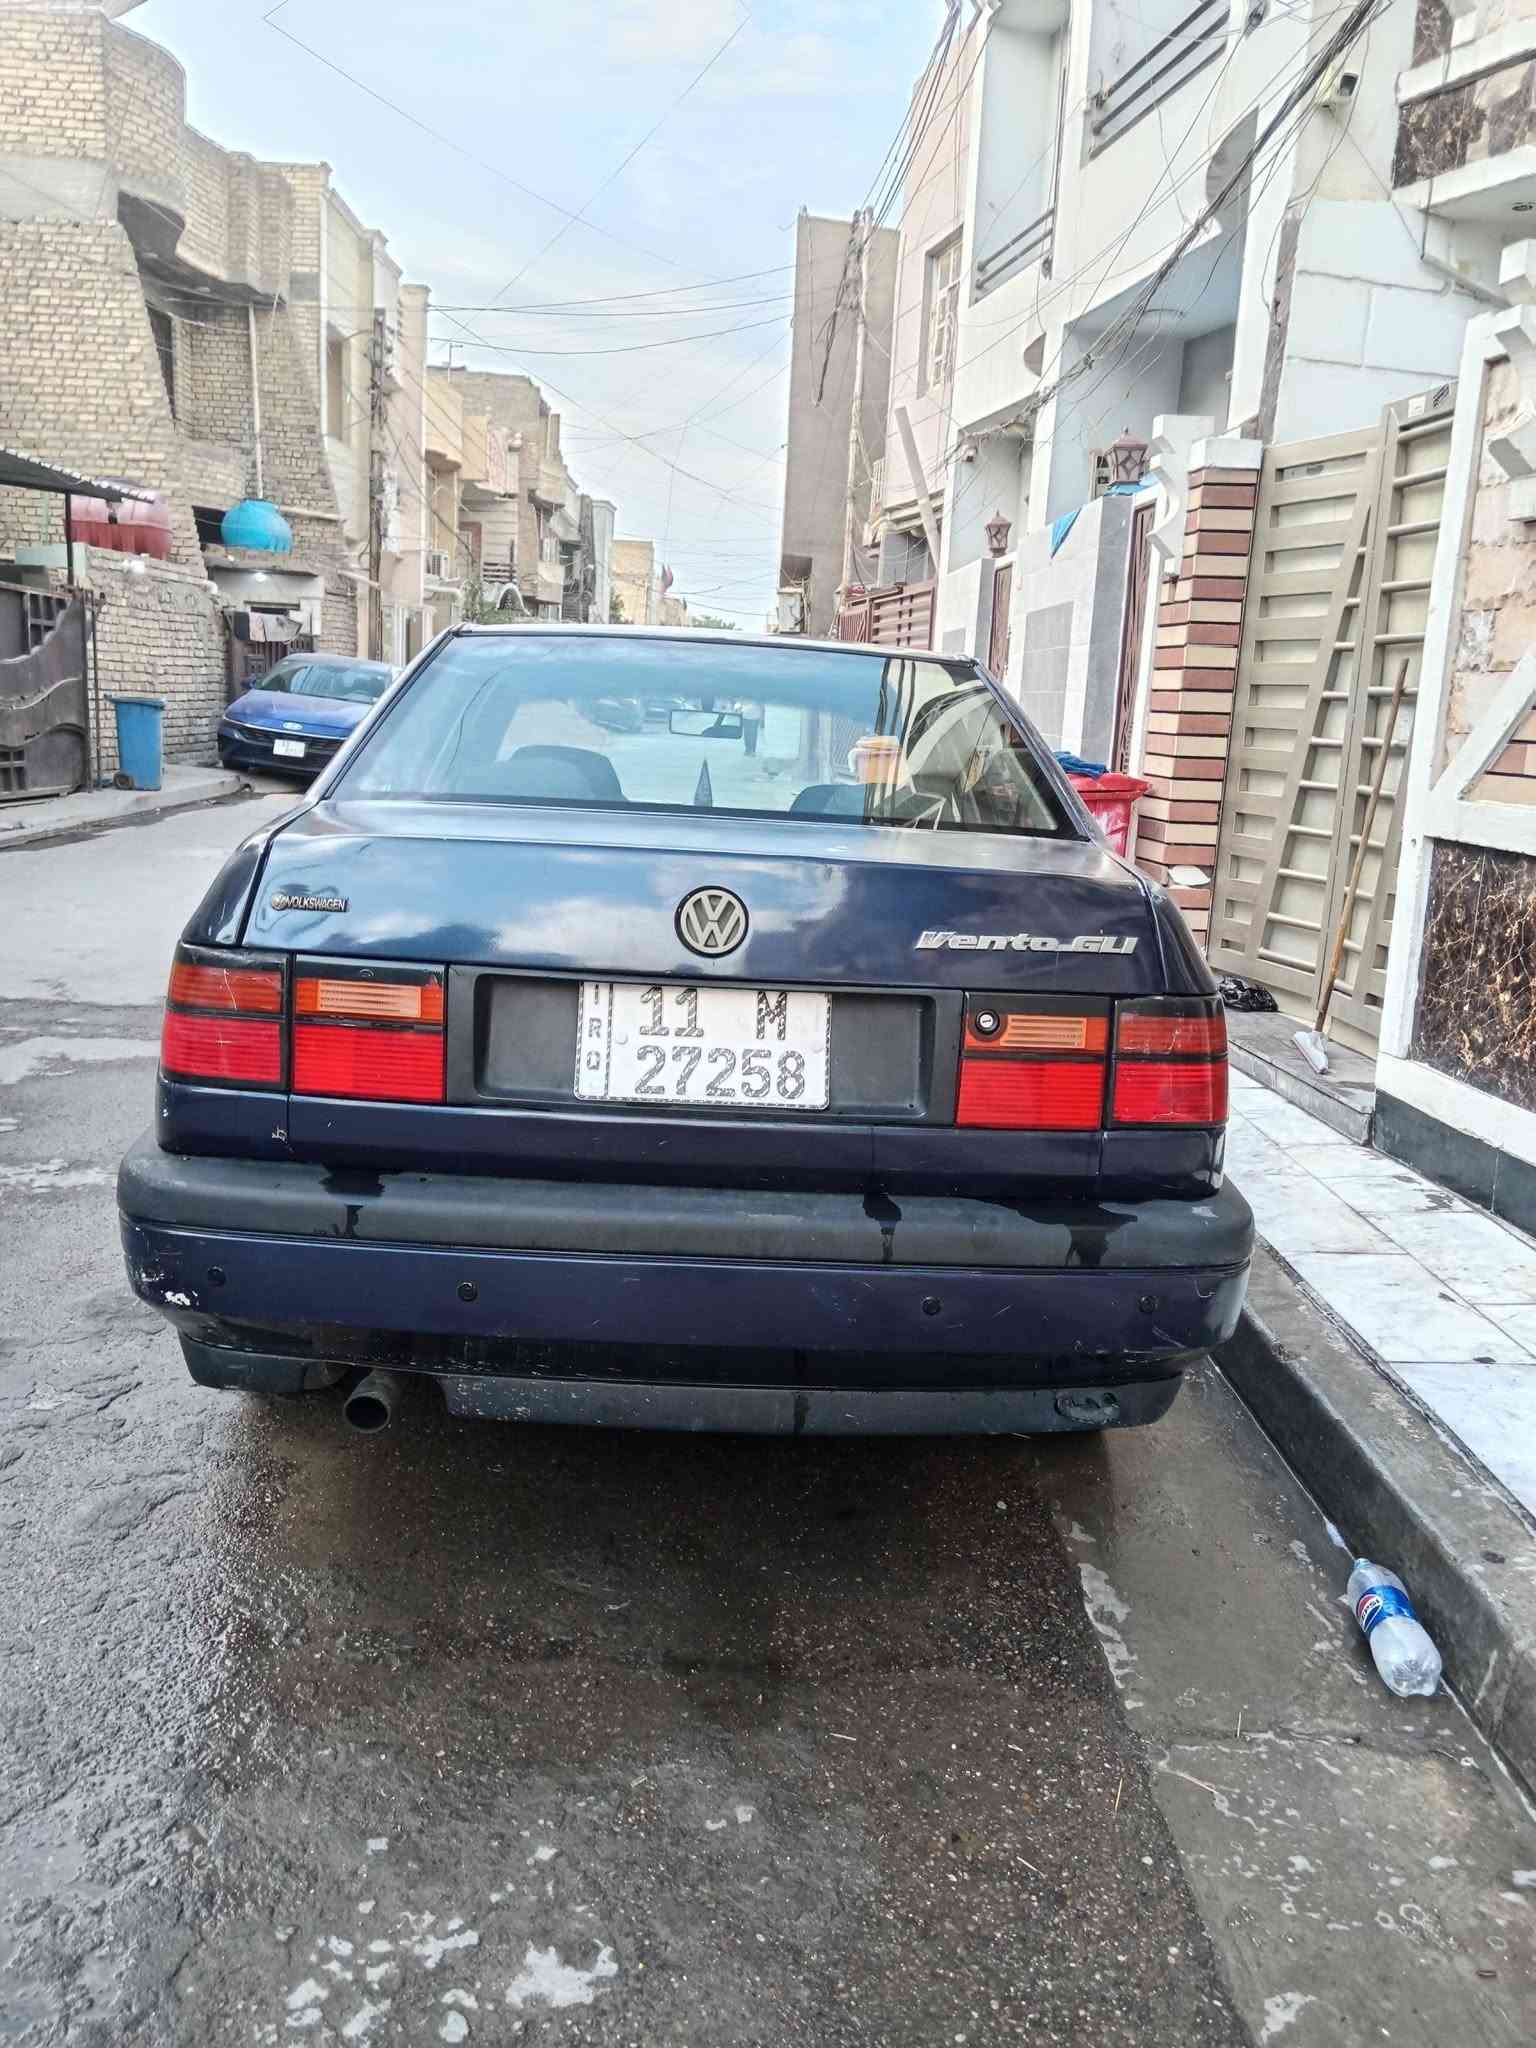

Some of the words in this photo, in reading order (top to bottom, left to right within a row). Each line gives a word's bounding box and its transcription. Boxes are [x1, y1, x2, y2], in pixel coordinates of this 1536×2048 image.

[287, 895, 346, 911] VOLKSWAGEN
[681, 890, 744, 952] VW
[915, 931, 1060, 951] Vento
[640, 986, 705, 1037] 11
[756, 991, 788, 1040] M
[635, 1044, 806, 1099] 27258
